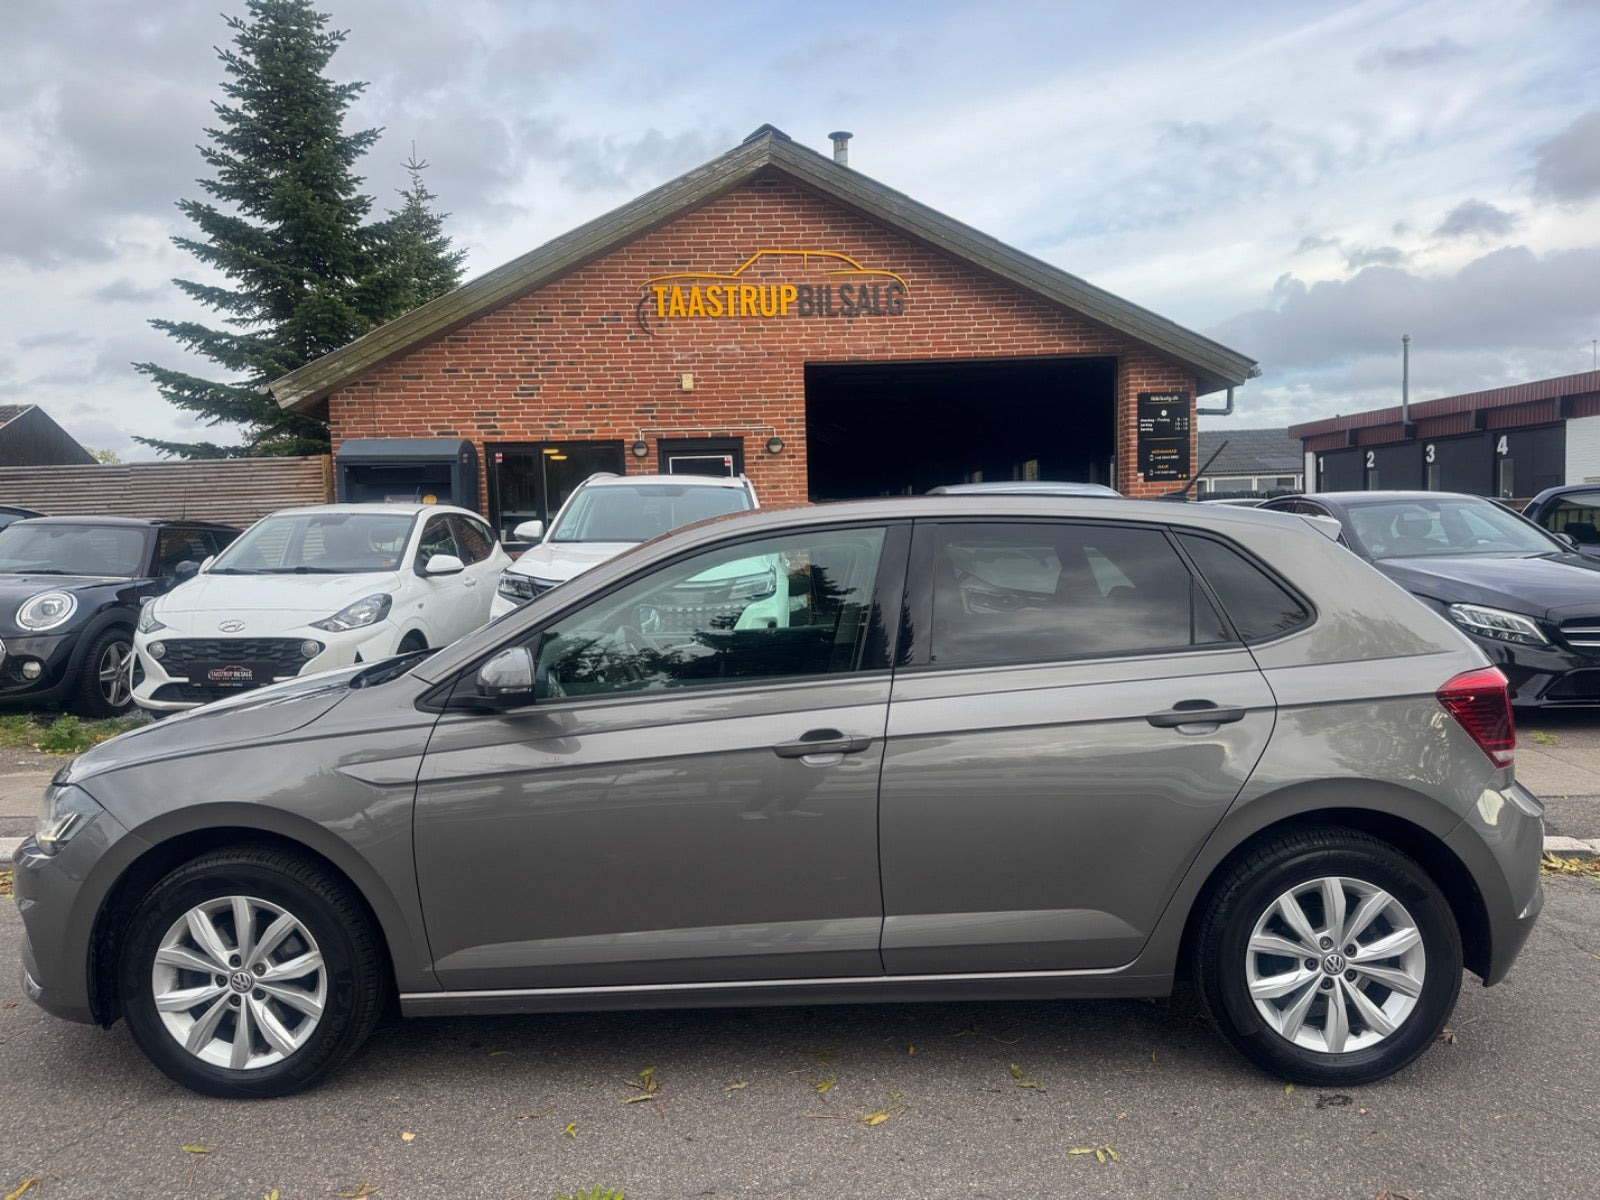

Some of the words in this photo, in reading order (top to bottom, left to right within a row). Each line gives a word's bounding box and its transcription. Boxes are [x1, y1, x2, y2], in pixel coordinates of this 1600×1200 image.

[1426, 444, 1435, 462] 3
[1497, 435, 1508, 455] 4
[1318, 457, 1324, 472] 1
[1366, 451, 1375, 467] 2
